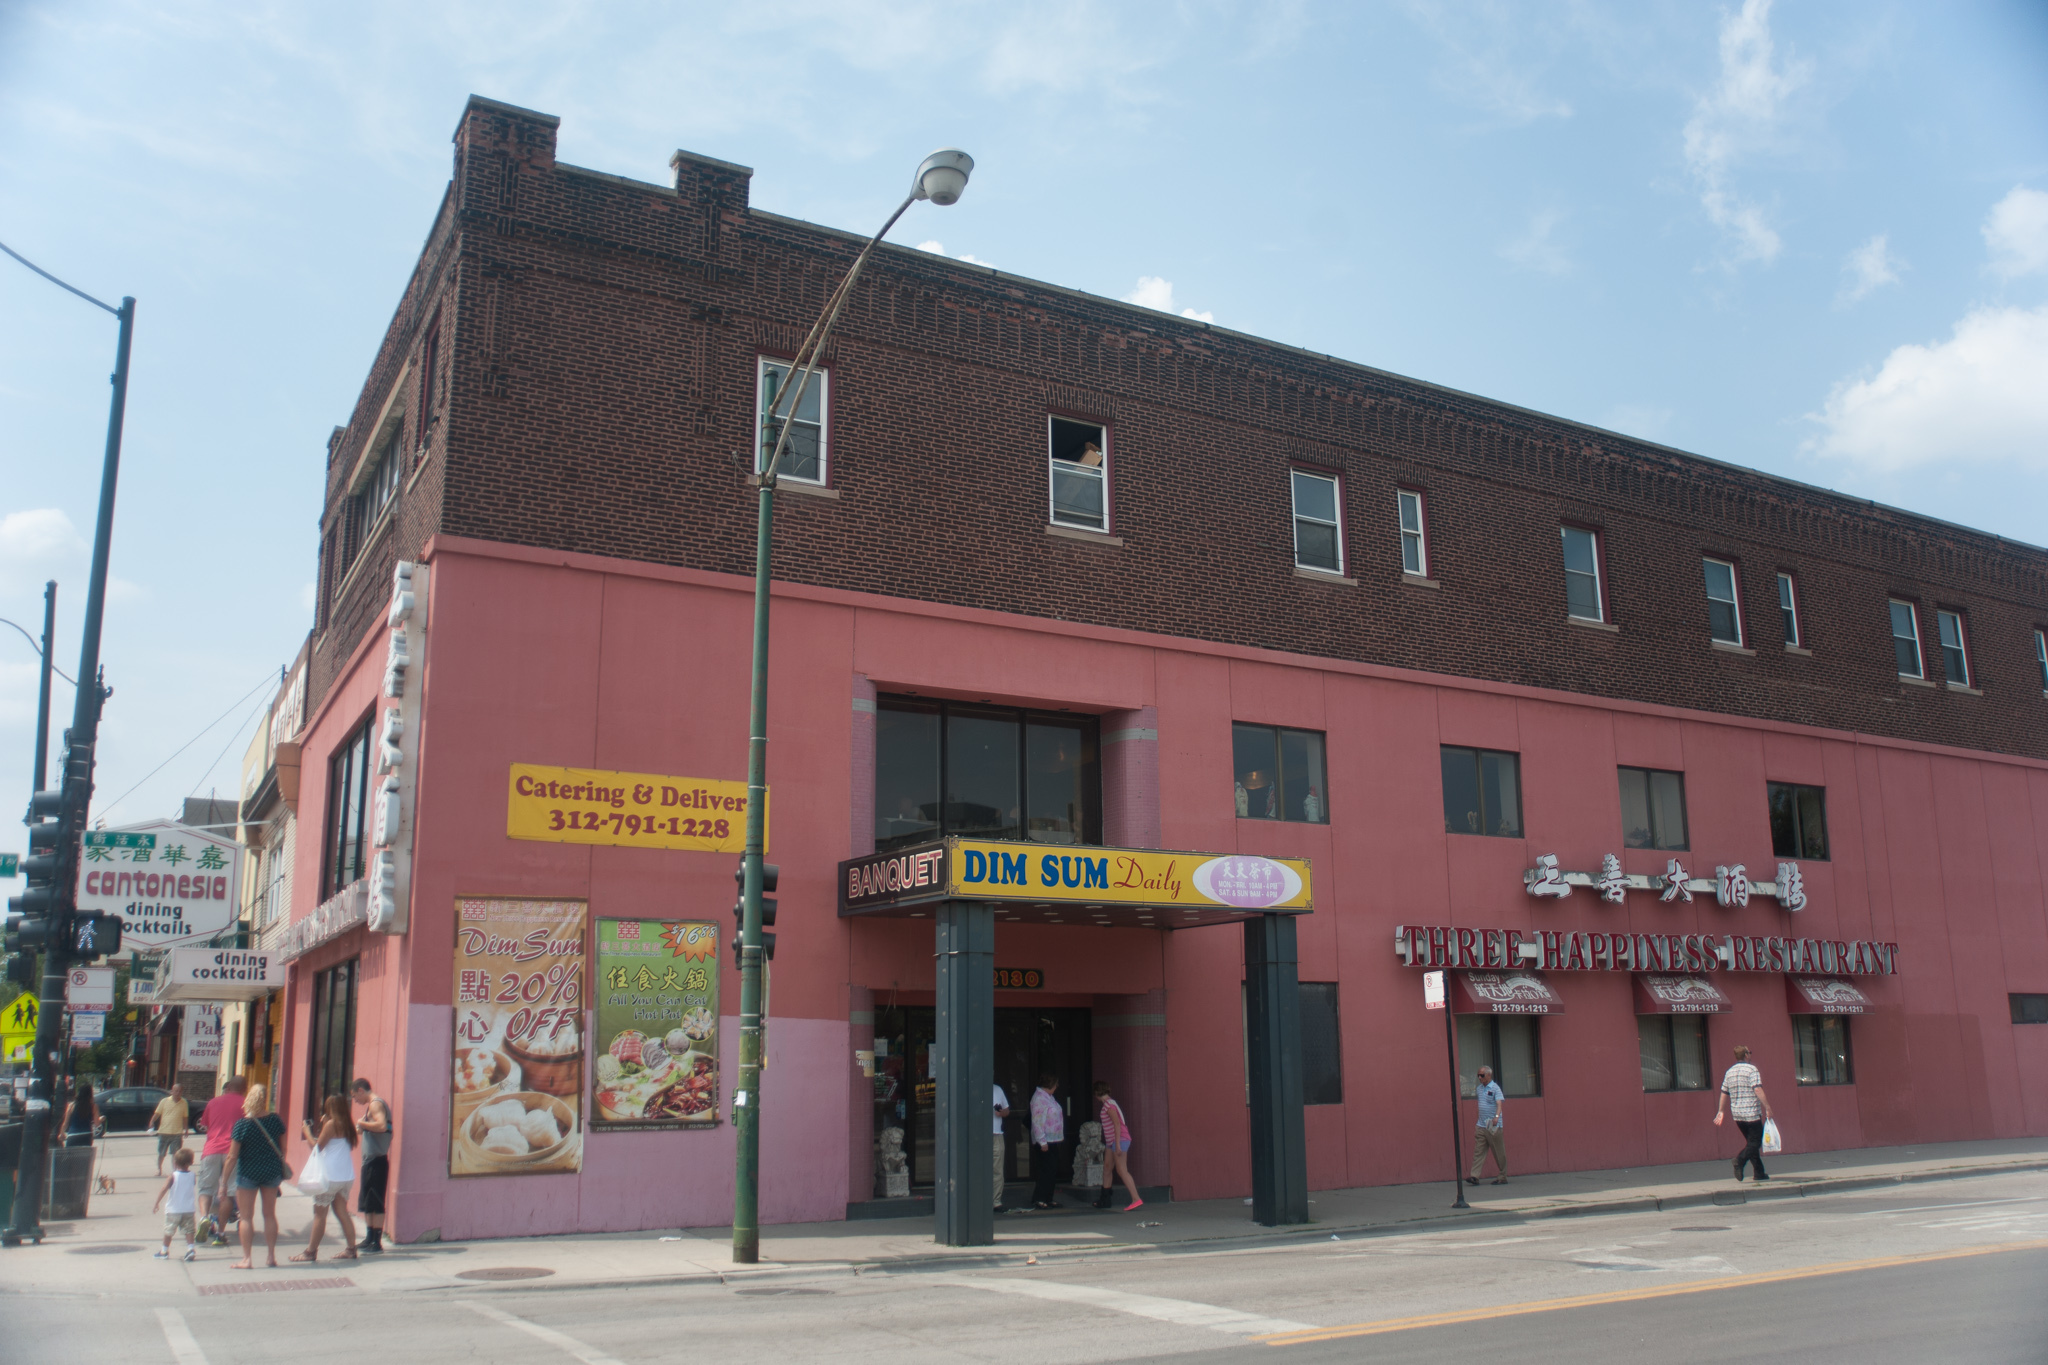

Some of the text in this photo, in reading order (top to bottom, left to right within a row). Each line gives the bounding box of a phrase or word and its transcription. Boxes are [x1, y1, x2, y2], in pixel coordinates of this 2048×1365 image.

[515, 775, 748, 812] Catering & Deliver
[548, 809, 730, 839] 312-791-1228
[848, 849, 943, 899] BANQUET
[963, 849, 1182, 900] DIM SUM Daily
[86, 870, 227, 900] cantonesia
[126, 902, 183, 919] dining
[122, 920, 192, 934] ocktails
[458, 927, 582, 962] Dim Sum
[1396, 925, 1899, 976] THREE HAPPINESS RESTAURANT
[214, 952, 268, 969] dining
[192, 968, 267, 980] cocktails
[1468, 972, 1501, 984] Sunday
[494, 961, 579, 1005] 20%
[608, 993, 708, 1006] All You Can Eat
[1492, 1003, 1548, 1012] 312-791-1213
[1672, 1004, 1719, 1012] 312-791-1213
[198, 1005, 223, 1015] Mo
[634, 1008, 681, 1020] Hot Pot
[193, 1021, 219, 1035] Pal
[505, 1007, 580, 1041] OFF
